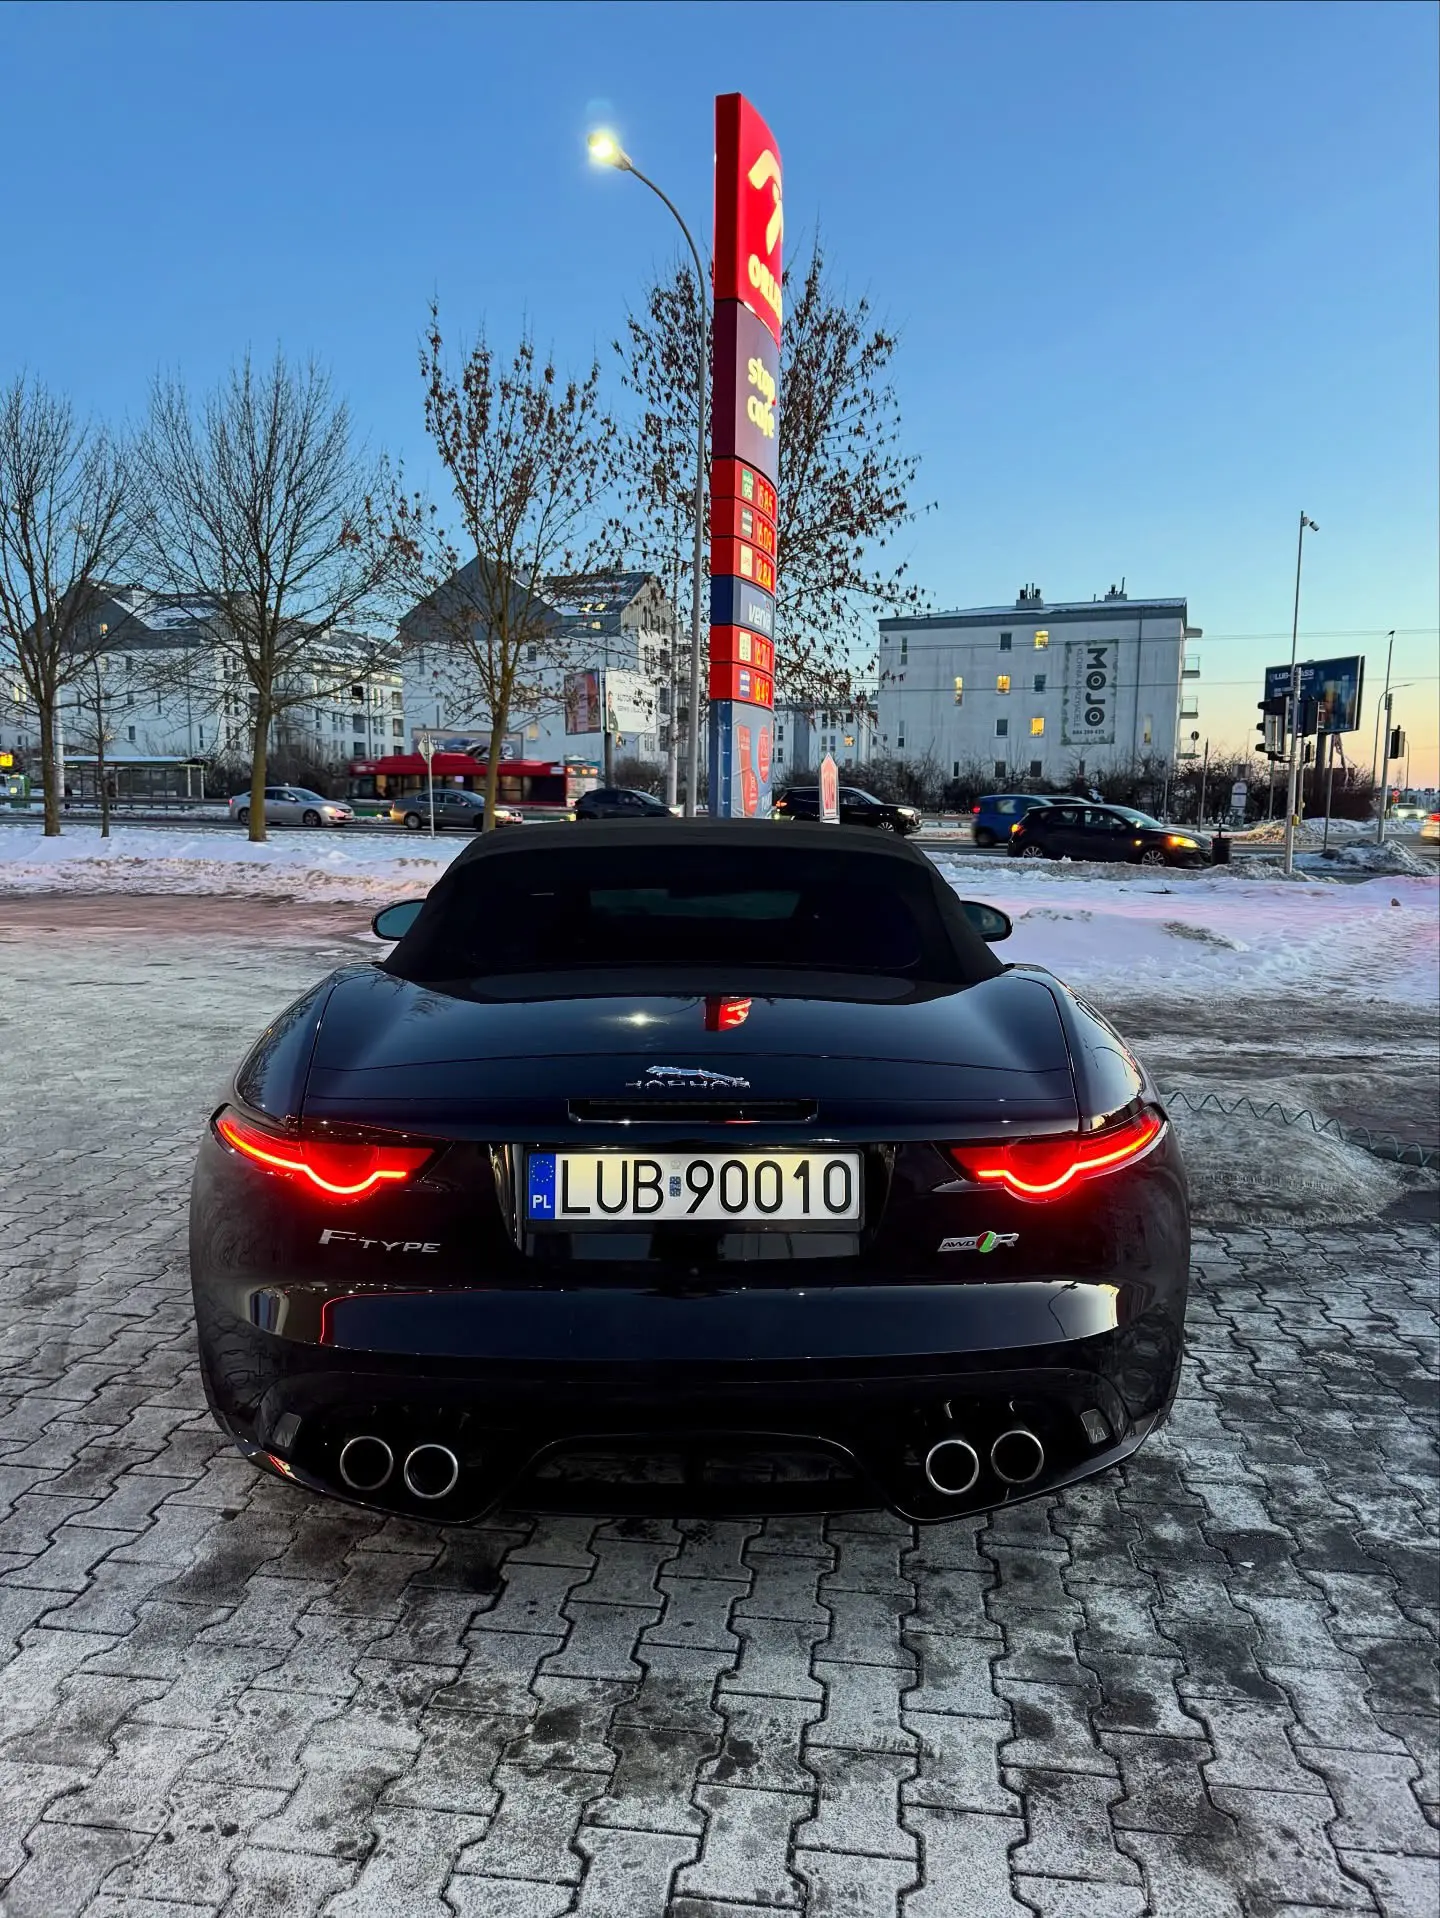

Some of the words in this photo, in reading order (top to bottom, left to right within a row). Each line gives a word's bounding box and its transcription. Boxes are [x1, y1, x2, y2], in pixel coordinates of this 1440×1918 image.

[1085, 647, 1107, 726] MOJO
[625, 1079, 750, 1089] JAGUAR
[562, 1159, 664, 1214] LUB
[685, 1159, 852, 1214] 90010
[532, 1195, 552, 1209] PL
[318, 1229, 441, 1253] F-TYPE
[943, 1240, 975, 1248] AWD
